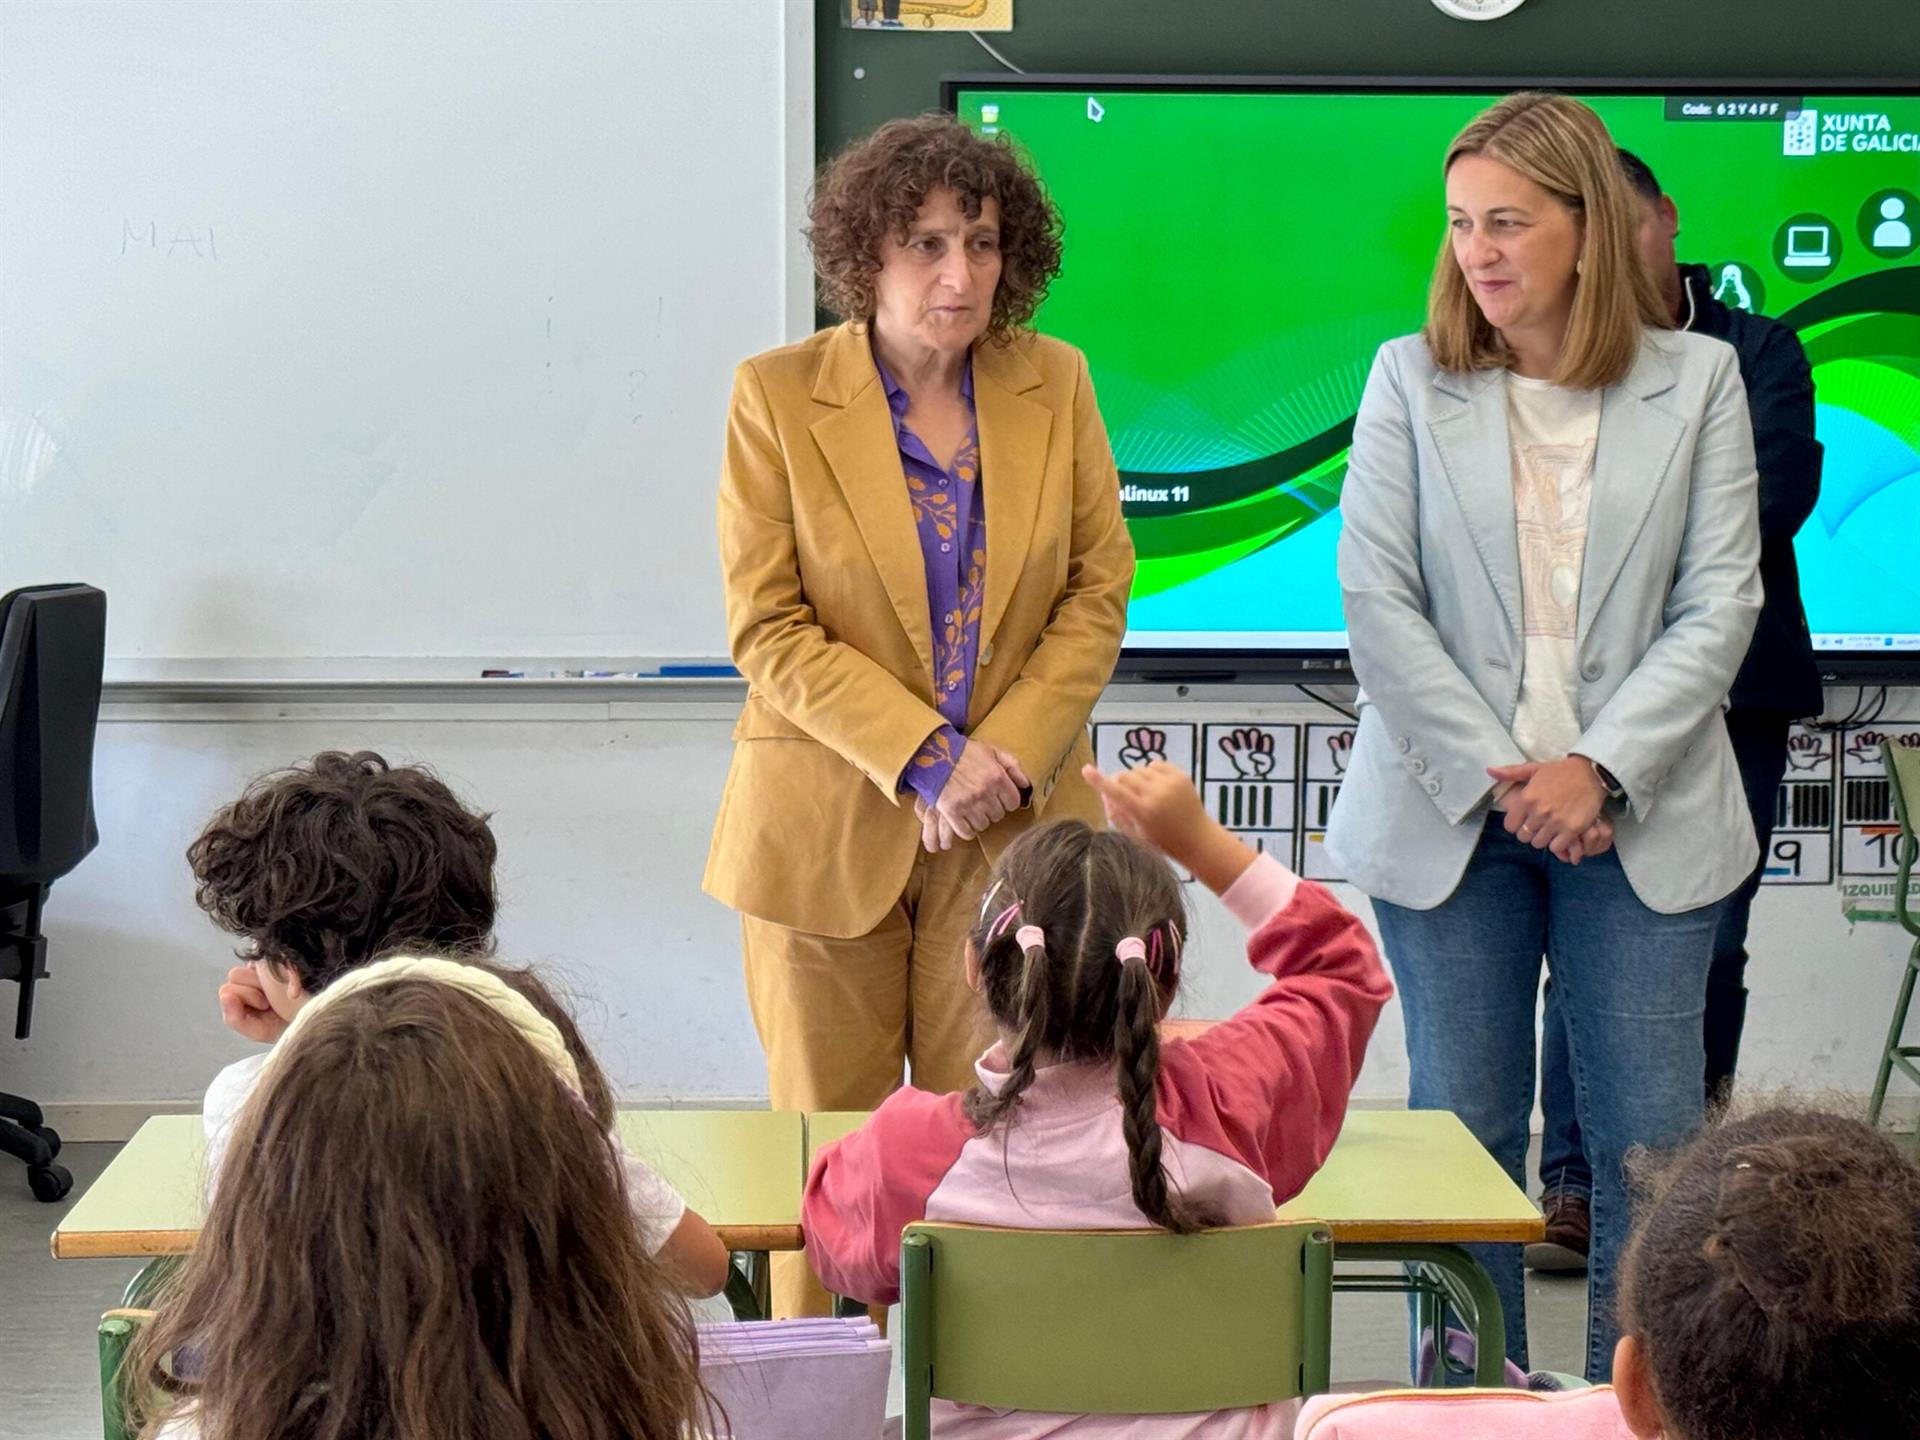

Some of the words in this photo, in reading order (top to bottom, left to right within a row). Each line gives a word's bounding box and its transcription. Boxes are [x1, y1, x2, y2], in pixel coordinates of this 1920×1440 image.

[1822, 114, 1891, 132] XUNTA
[1821, 133, 1848, 152] DE
[1852, 133, 1920, 152] GALICI
[1171, 486, 1190, 502] 11
[1773, 840, 1801, 877] 9
